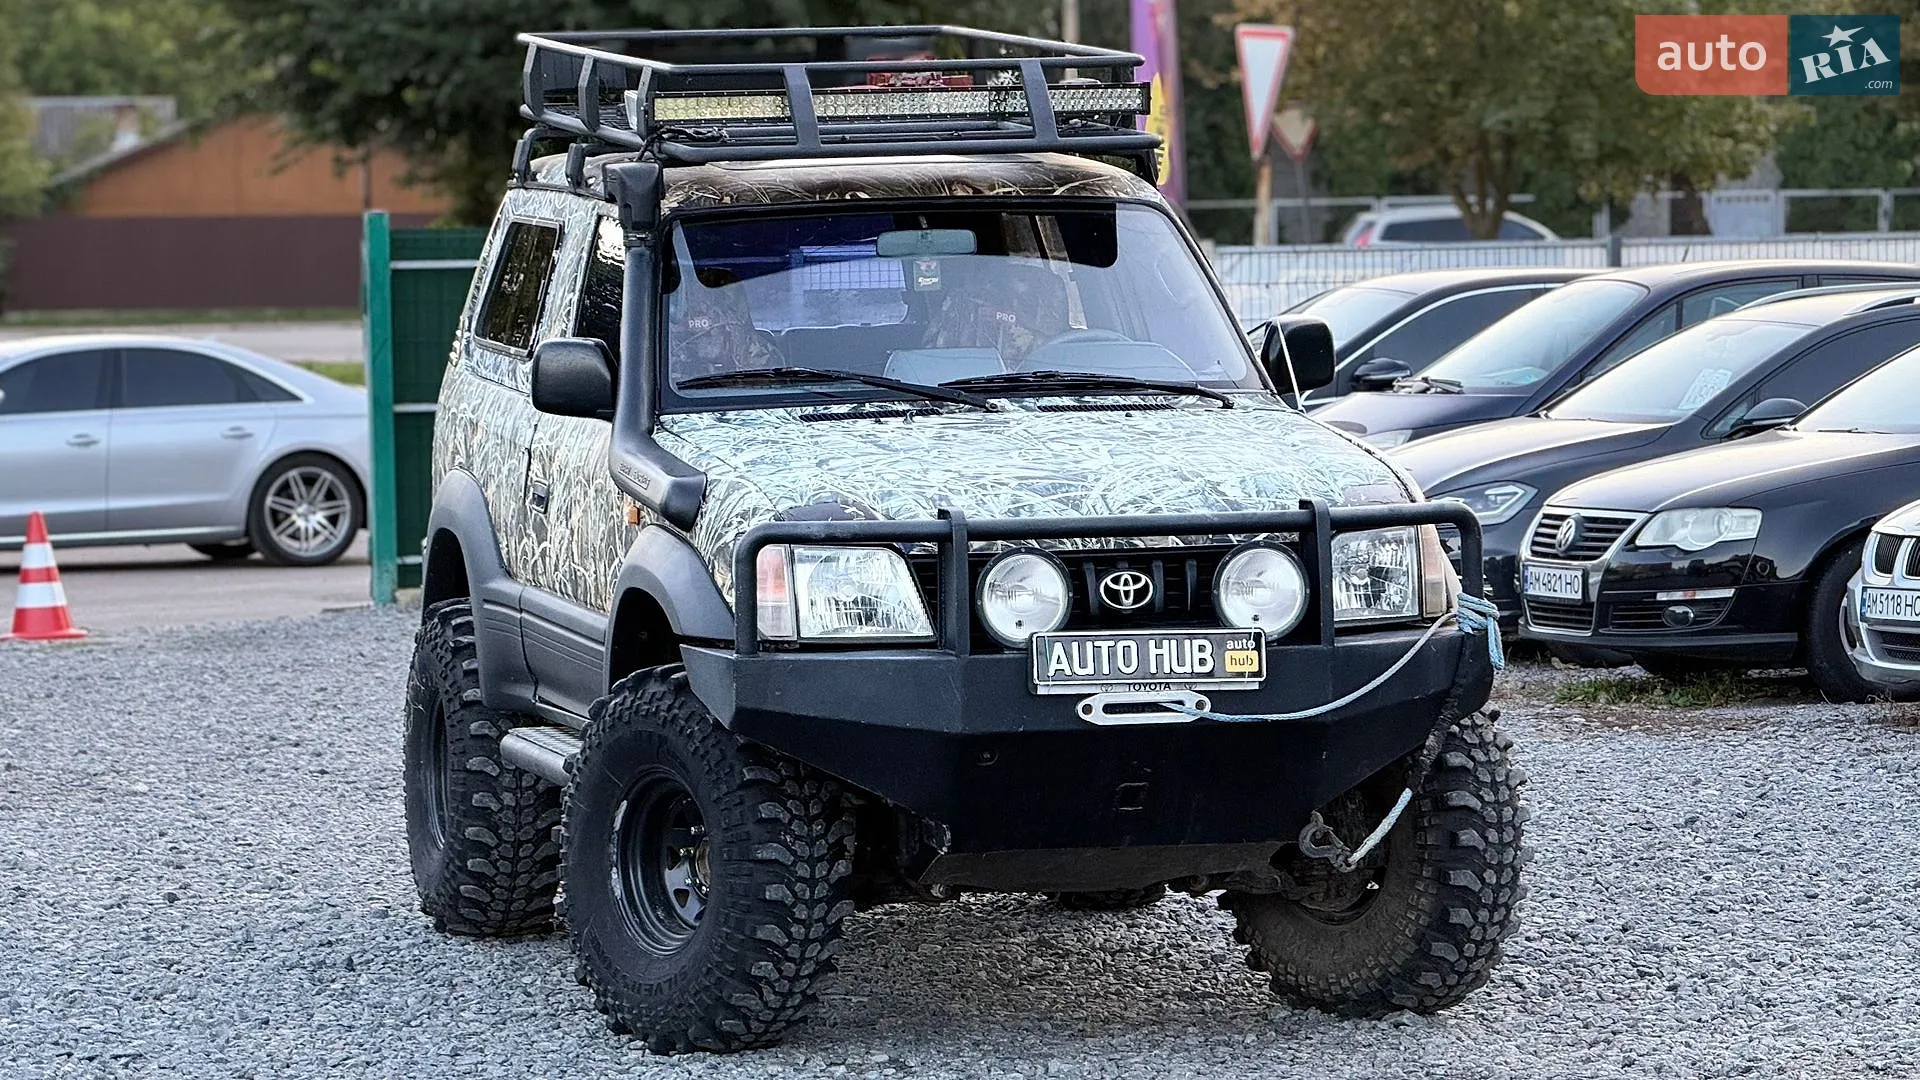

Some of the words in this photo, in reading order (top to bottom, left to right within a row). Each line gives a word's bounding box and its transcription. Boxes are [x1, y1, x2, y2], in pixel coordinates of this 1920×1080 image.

[996, 312, 1016, 322] PRO
[688, 319, 709, 328] PRO
[1529, 571, 1541, 591] AM
[1542, 572, 1563, 593] 4821
[1565, 574, 1580, 594] HO
[1866, 592, 1878, 614] AM
[1879, 593, 1902, 616] 5118
[1226, 639, 1256, 650] auto
[1048, 639, 1139, 677] AUTO
[1148, 639, 1215, 674] HUB
[1230, 654, 1254, 666] hub
[1127, 682, 1171, 692] TOYOTA
